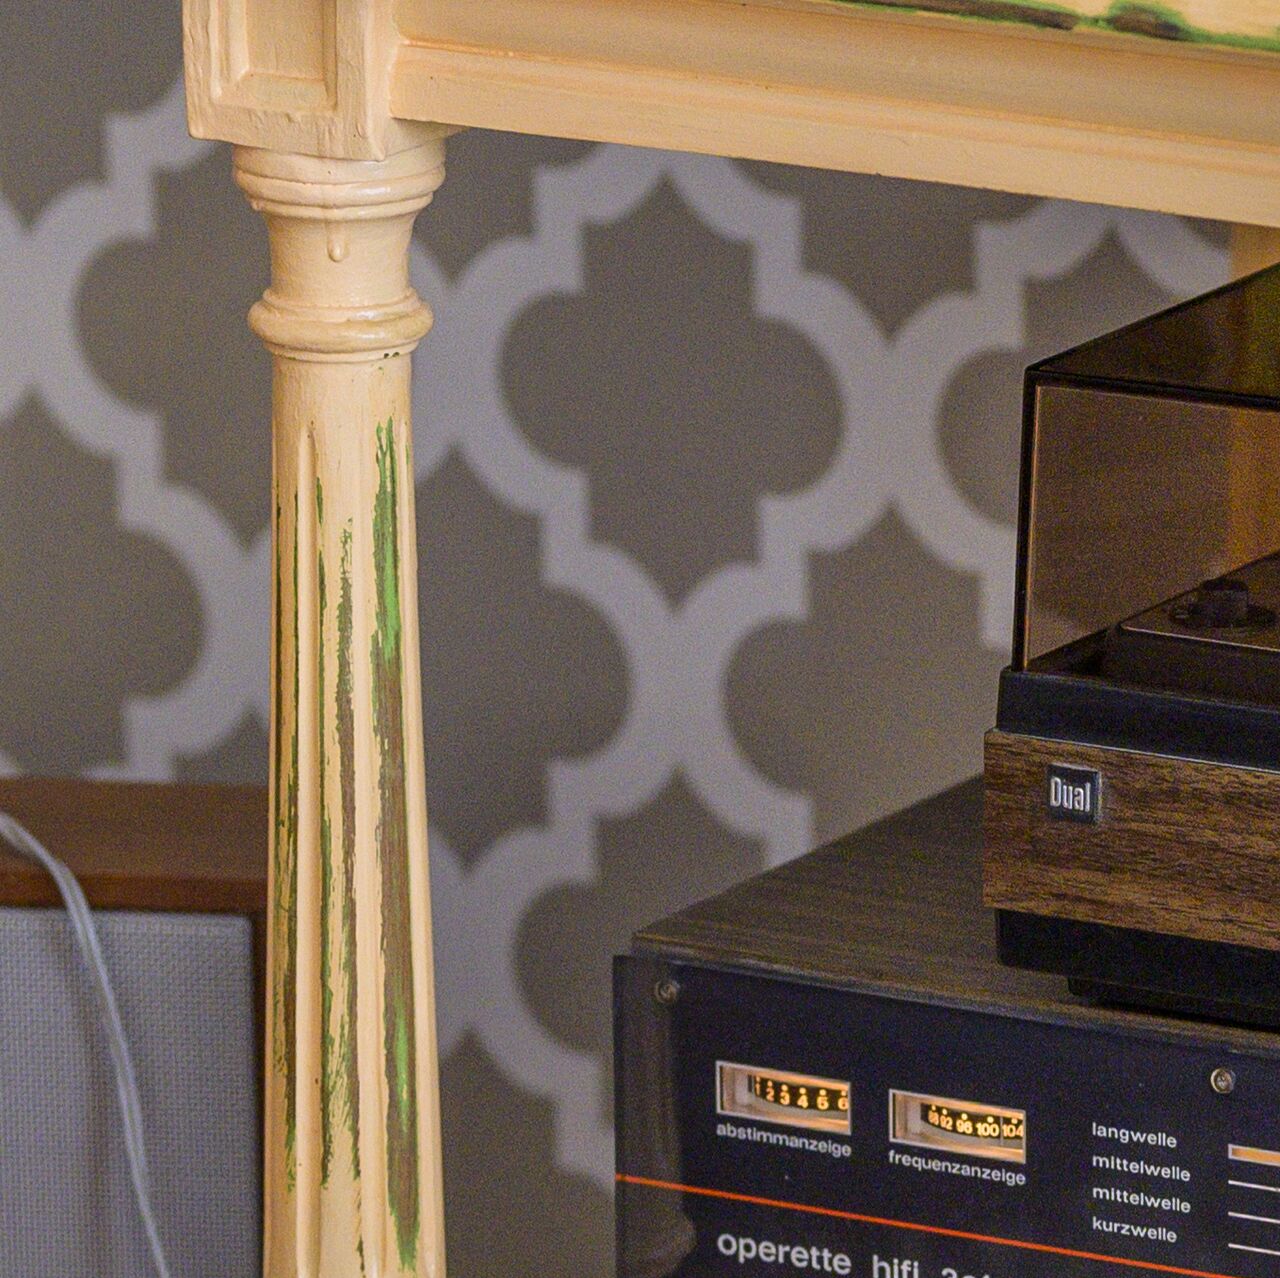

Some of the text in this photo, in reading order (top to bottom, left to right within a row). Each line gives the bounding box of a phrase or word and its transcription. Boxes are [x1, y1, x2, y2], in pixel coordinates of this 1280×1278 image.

[1050, 777, 1090, 812] Dual
[766, 1087, 774, 1101] 2
[780, 1091, 789, 1105] 3
[798, 1095, 808, 1108] 4
[817, 1096, 828, 1109] 5
[940, 1115, 953, 1130] 92
[956, 1119, 972, 1133] 96
[977, 1122, 999, 1136] 100
[1003, 1123, 1024, 1137] 104
[1092, 1122, 1177, 1148] langwelle
[717, 1123, 851, 1156] abstimmanzeige
[889, 1150, 1026, 1185] frequenzanzeige
[1093, 1156, 1190, 1180] mittelwelle
[1093, 1186, 1191, 1212] mittelwelle
[1092, 1217, 1177, 1243] kurzwelle
[718, 1232, 852, 1276] operette
